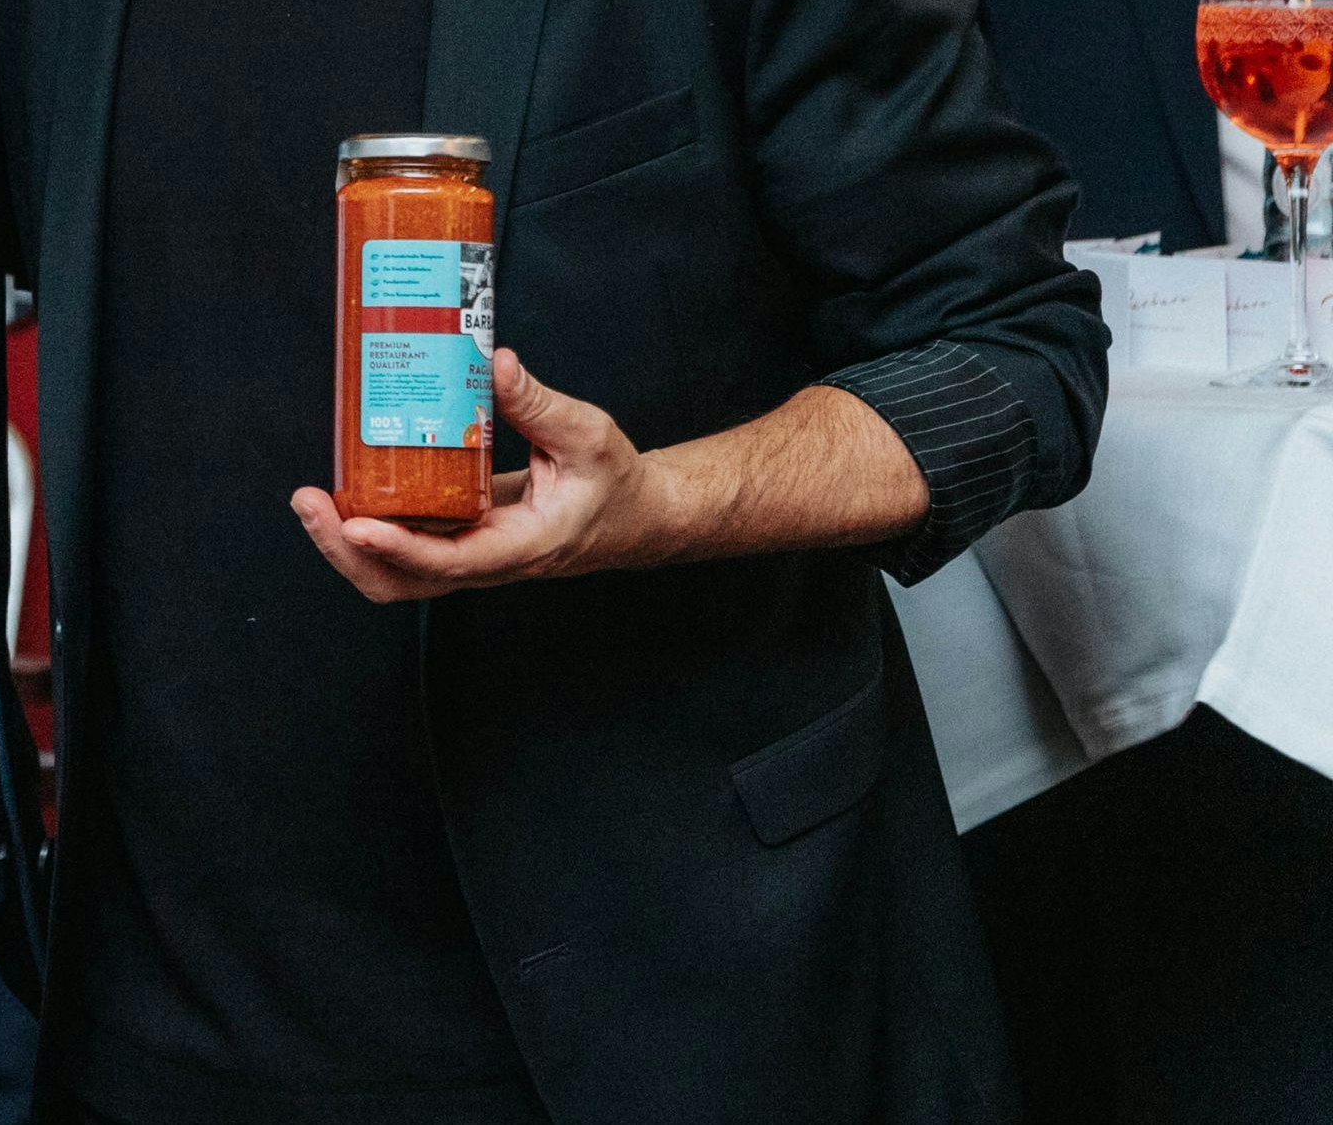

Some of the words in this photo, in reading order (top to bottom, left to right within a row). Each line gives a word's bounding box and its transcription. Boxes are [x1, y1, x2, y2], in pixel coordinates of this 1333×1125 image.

[369, 341, 411, 349] PREMIUM
[370, 417, 391, 428] 100
[392, 417, 403, 428] %
